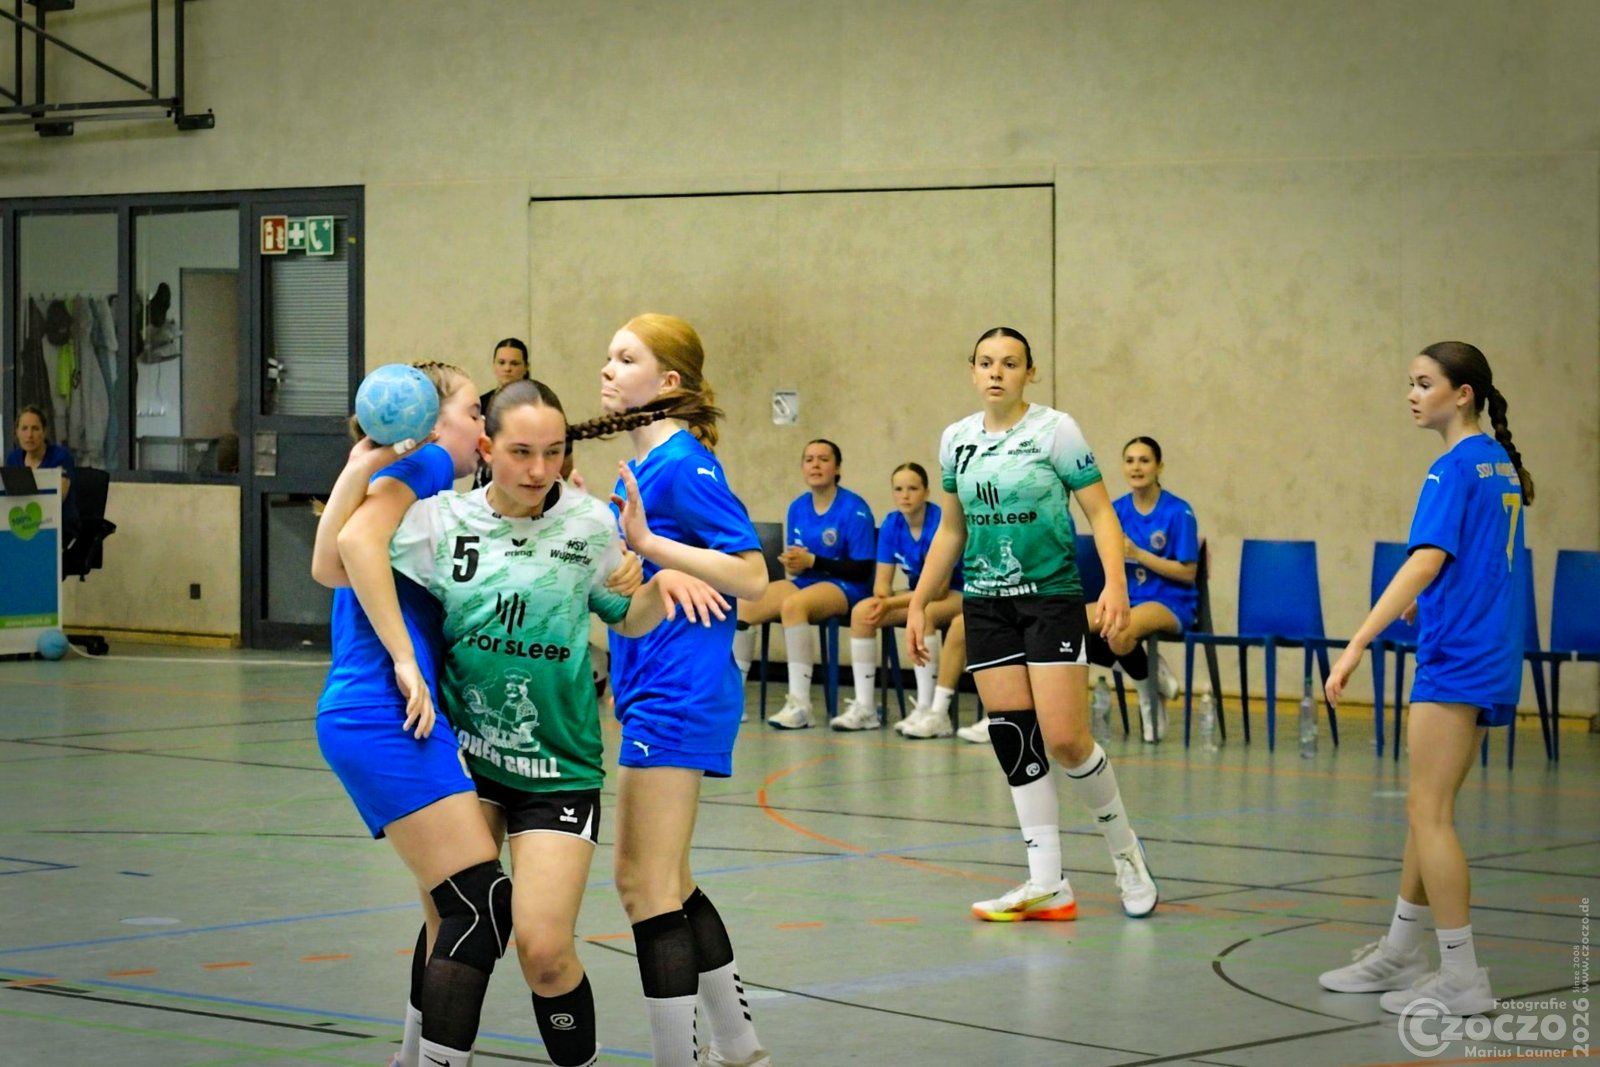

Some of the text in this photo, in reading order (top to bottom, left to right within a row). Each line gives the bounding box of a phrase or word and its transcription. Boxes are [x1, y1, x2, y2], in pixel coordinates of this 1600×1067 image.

[954, 444, 977, 474] 17
[567, 540, 588, 551] HSV
[1502, 493, 1521, 572] 7
[452, 536, 480, 582] 5
[503, 757, 561, 778] GRILL
